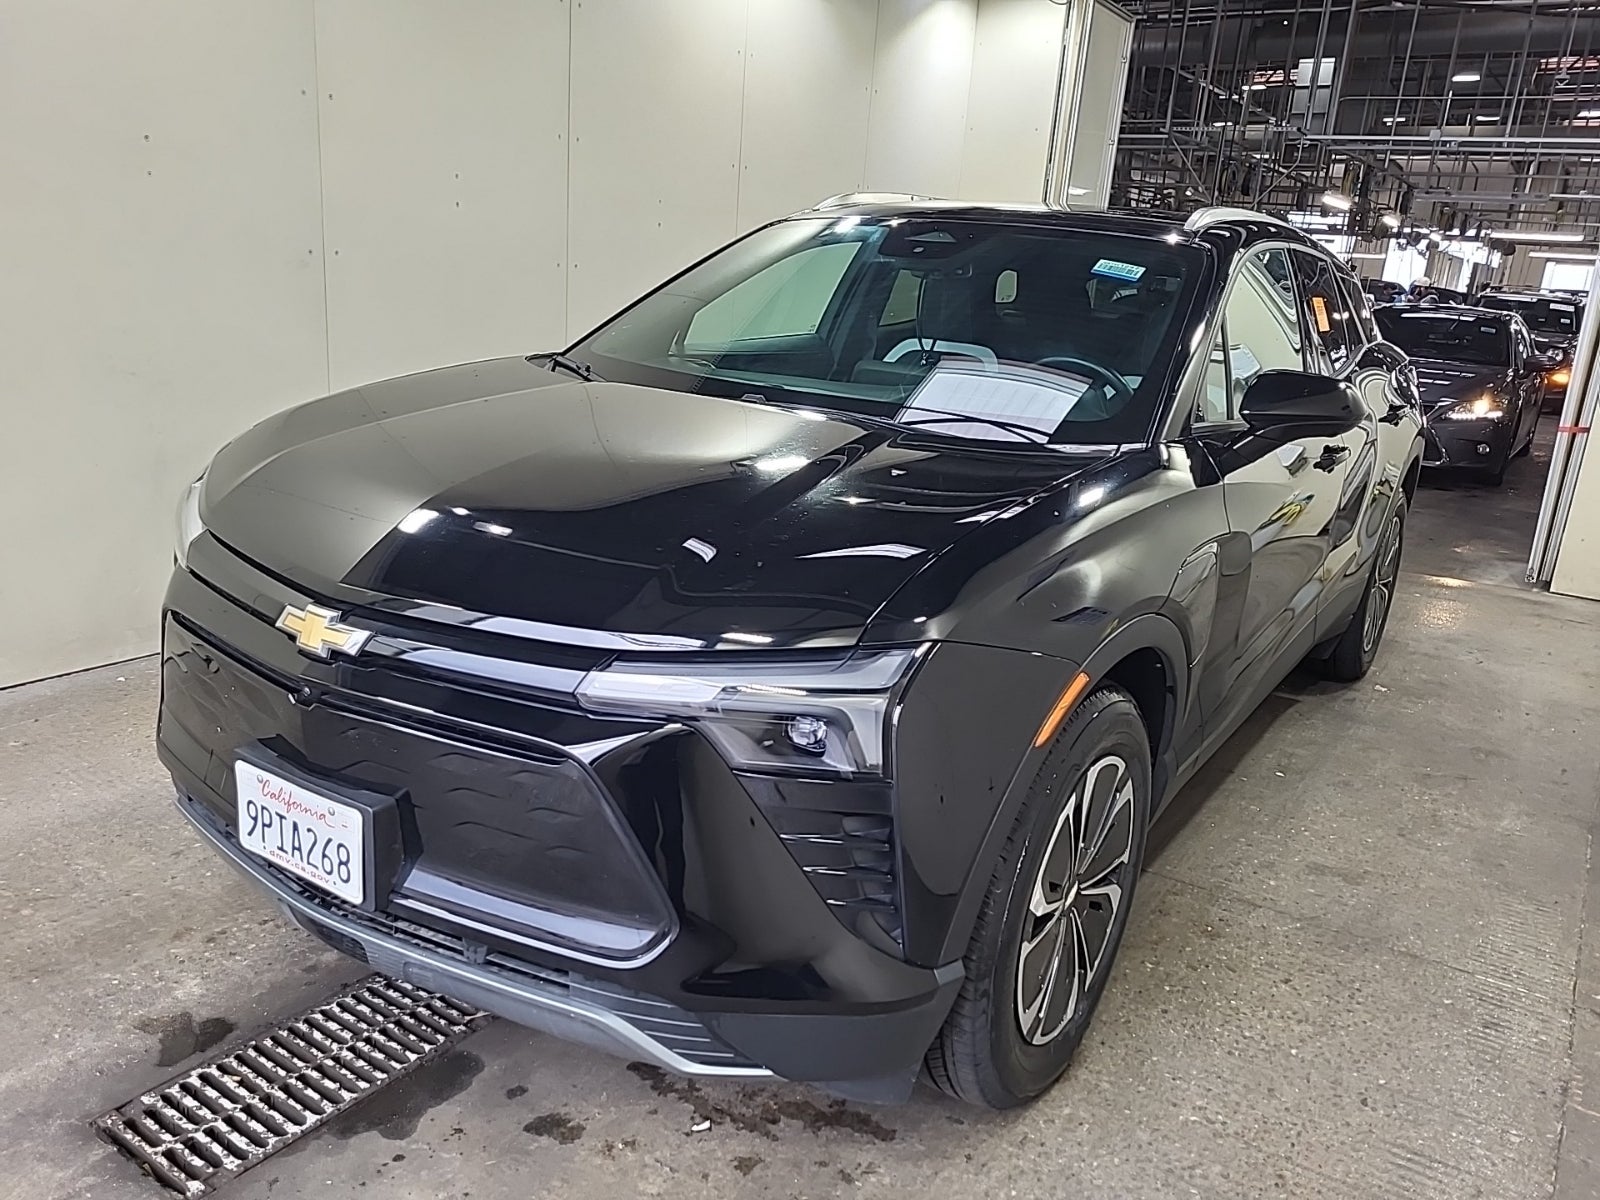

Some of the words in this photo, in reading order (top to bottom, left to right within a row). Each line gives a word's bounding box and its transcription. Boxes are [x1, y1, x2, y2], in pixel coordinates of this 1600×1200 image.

[262, 780, 335, 828] California
[247, 800, 350, 884] 9PIA268
[269, 850, 330, 884] dmv.ca.gov
